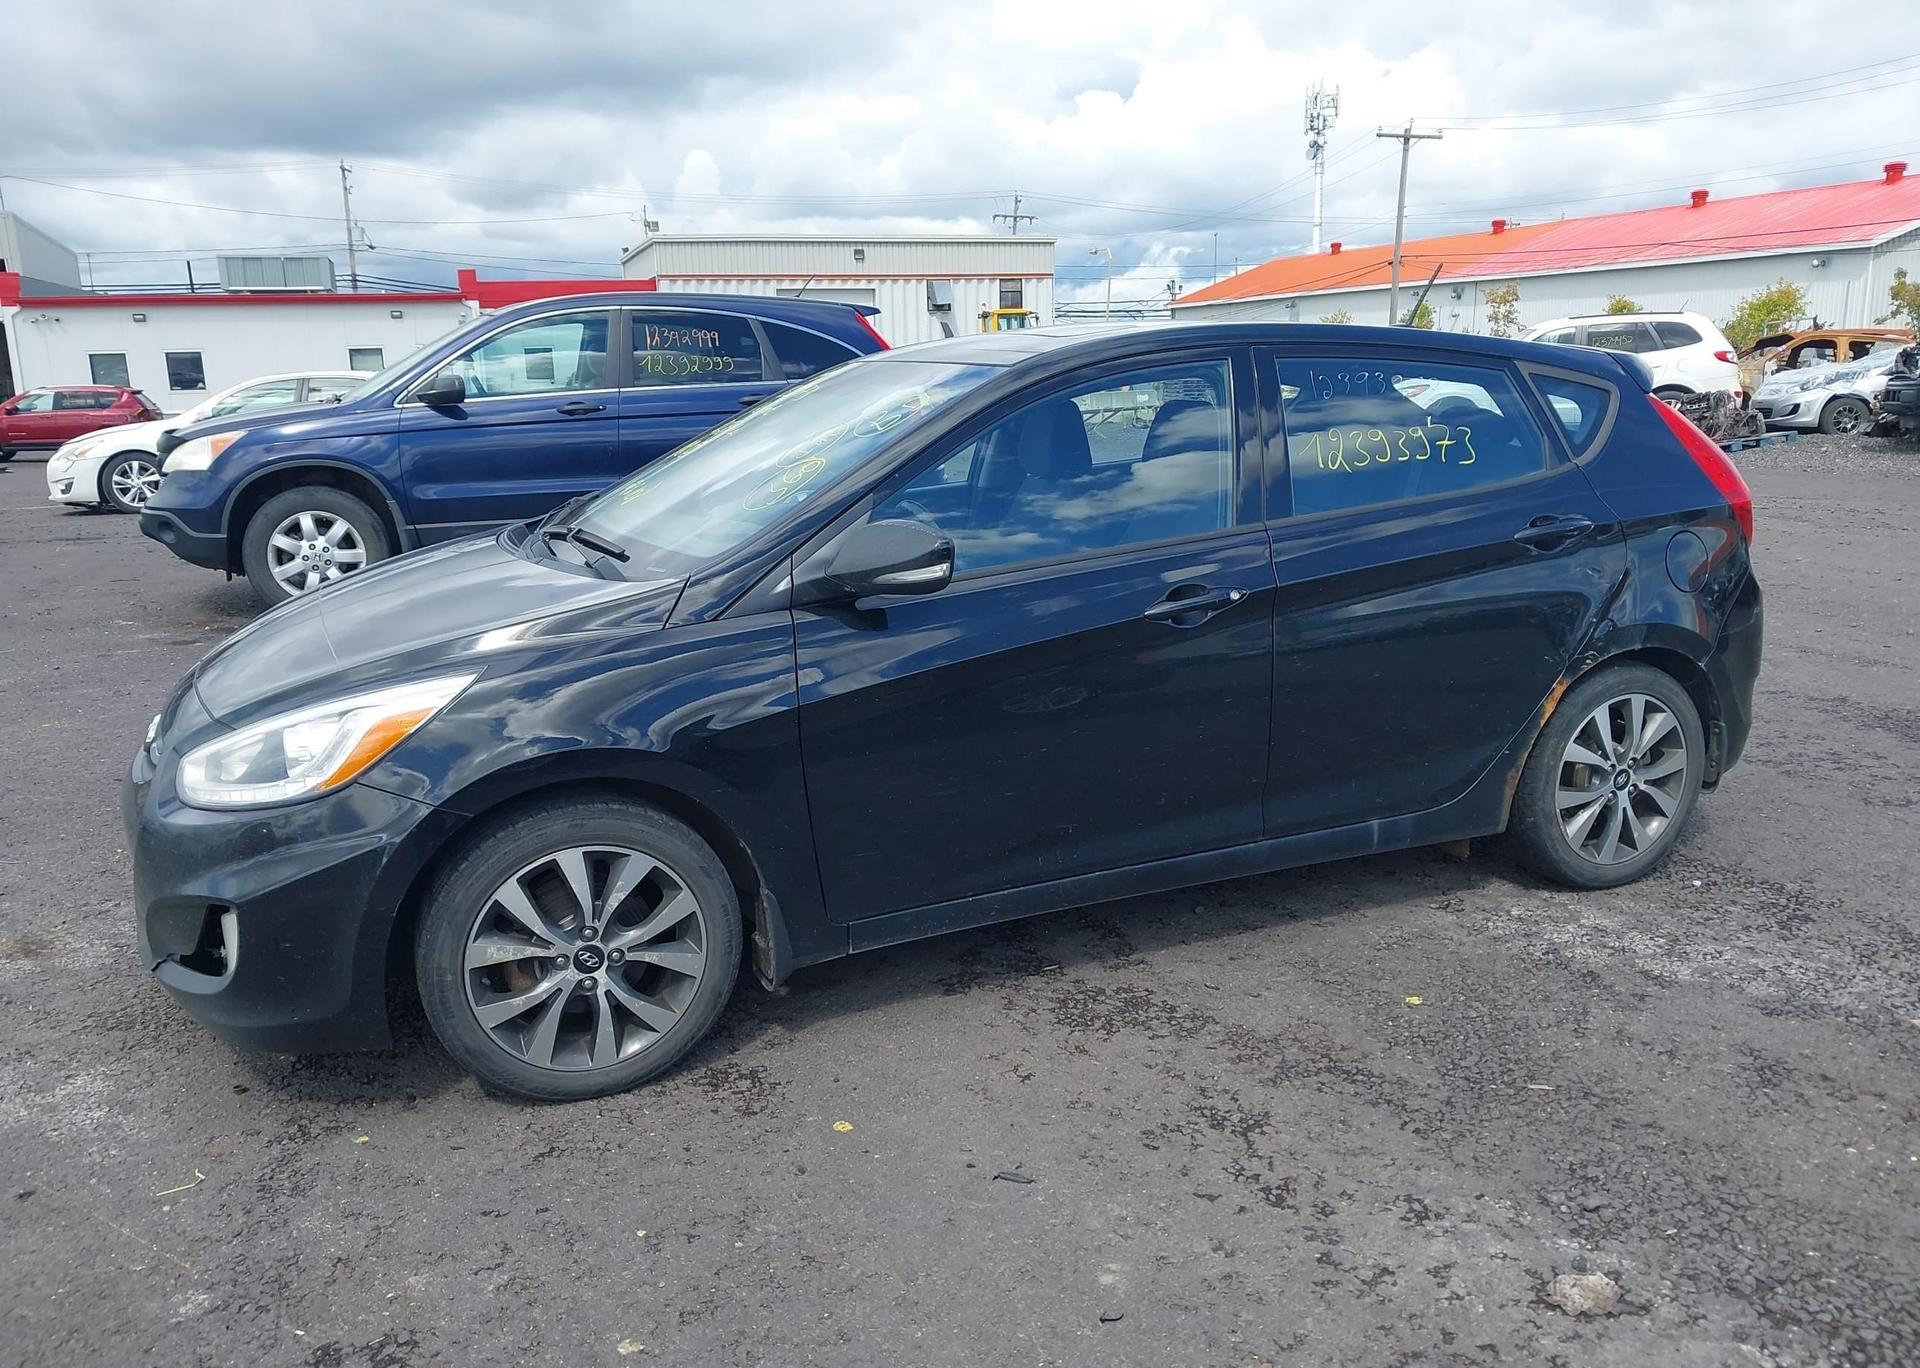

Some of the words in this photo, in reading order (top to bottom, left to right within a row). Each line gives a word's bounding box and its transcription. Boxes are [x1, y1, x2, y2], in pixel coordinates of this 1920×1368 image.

[645, 323, 720, 350] 12392999
[638, 353, 734, 376] 12392999
[1299, 416, 1477, 473] 12393973
